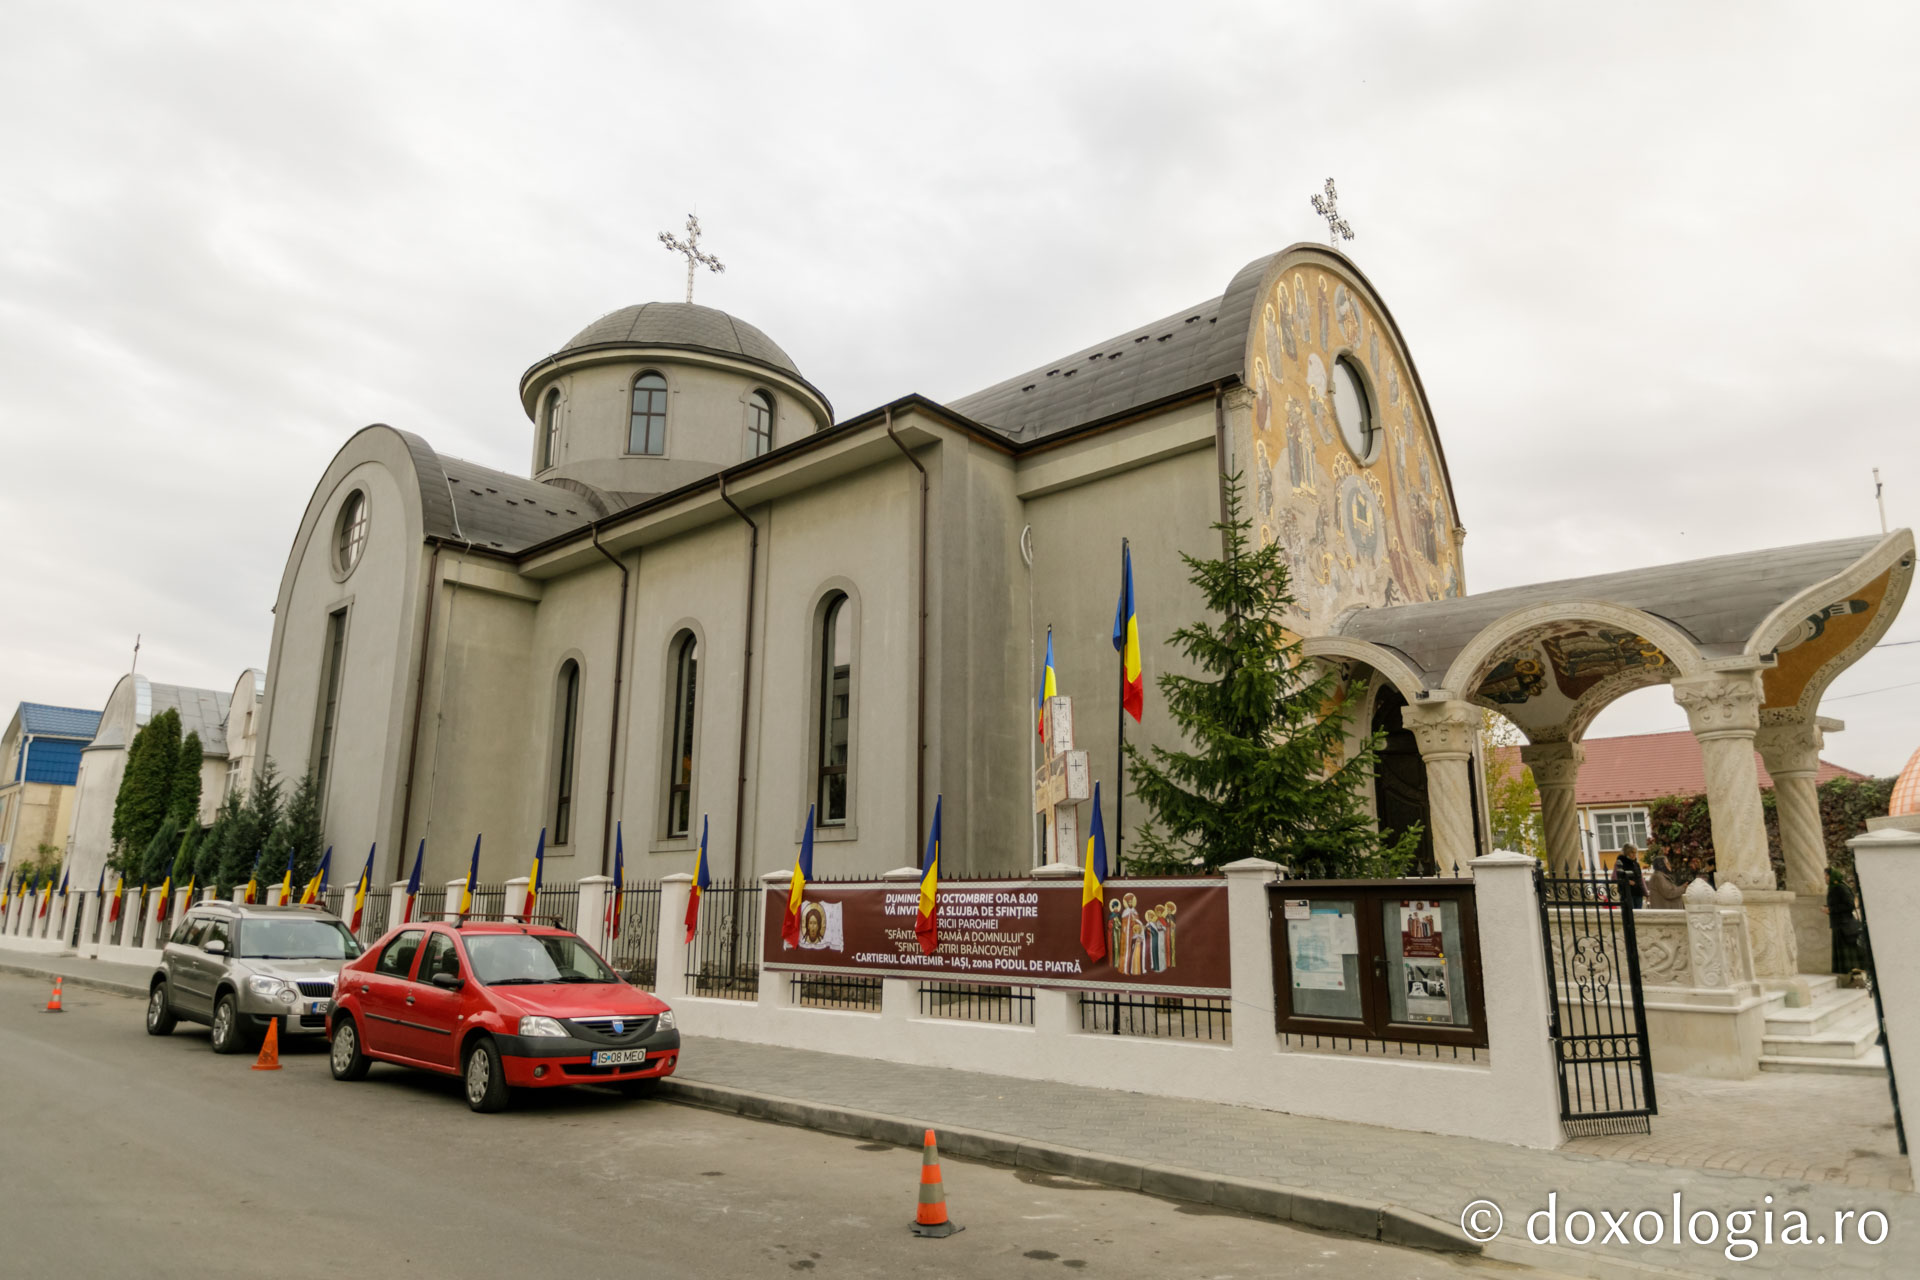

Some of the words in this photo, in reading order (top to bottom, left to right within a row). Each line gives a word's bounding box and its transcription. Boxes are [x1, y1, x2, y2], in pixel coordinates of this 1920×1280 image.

[886, 894, 920, 904] DUMINIC
[942, 894, 994, 904] OCTOMBRIE
[996, 893, 1017, 903] ORA
[1019, 893, 1038, 903] 8.00
[885, 904, 896, 916] VĂ
[897, 906, 919, 916] INVIT
[946, 906, 979, 916] SLUJBA
[981, 906, 994, 916] DE
[959, 919, 998, 929] PAROHIEI
[938, 929, 963, 941] RAMĂ
[964, 932, 970, 942] A
[856, 953, 899, 964] CARTIERUL
[900, 954, 944, 966] CANTEMIR
[972, 960, 992, 968] zona
[995, 959, 1027, 970] PODUL
[1030, 961, 1042, 971] DE
[1045, 960, 1082, 973] PIATRĂ
